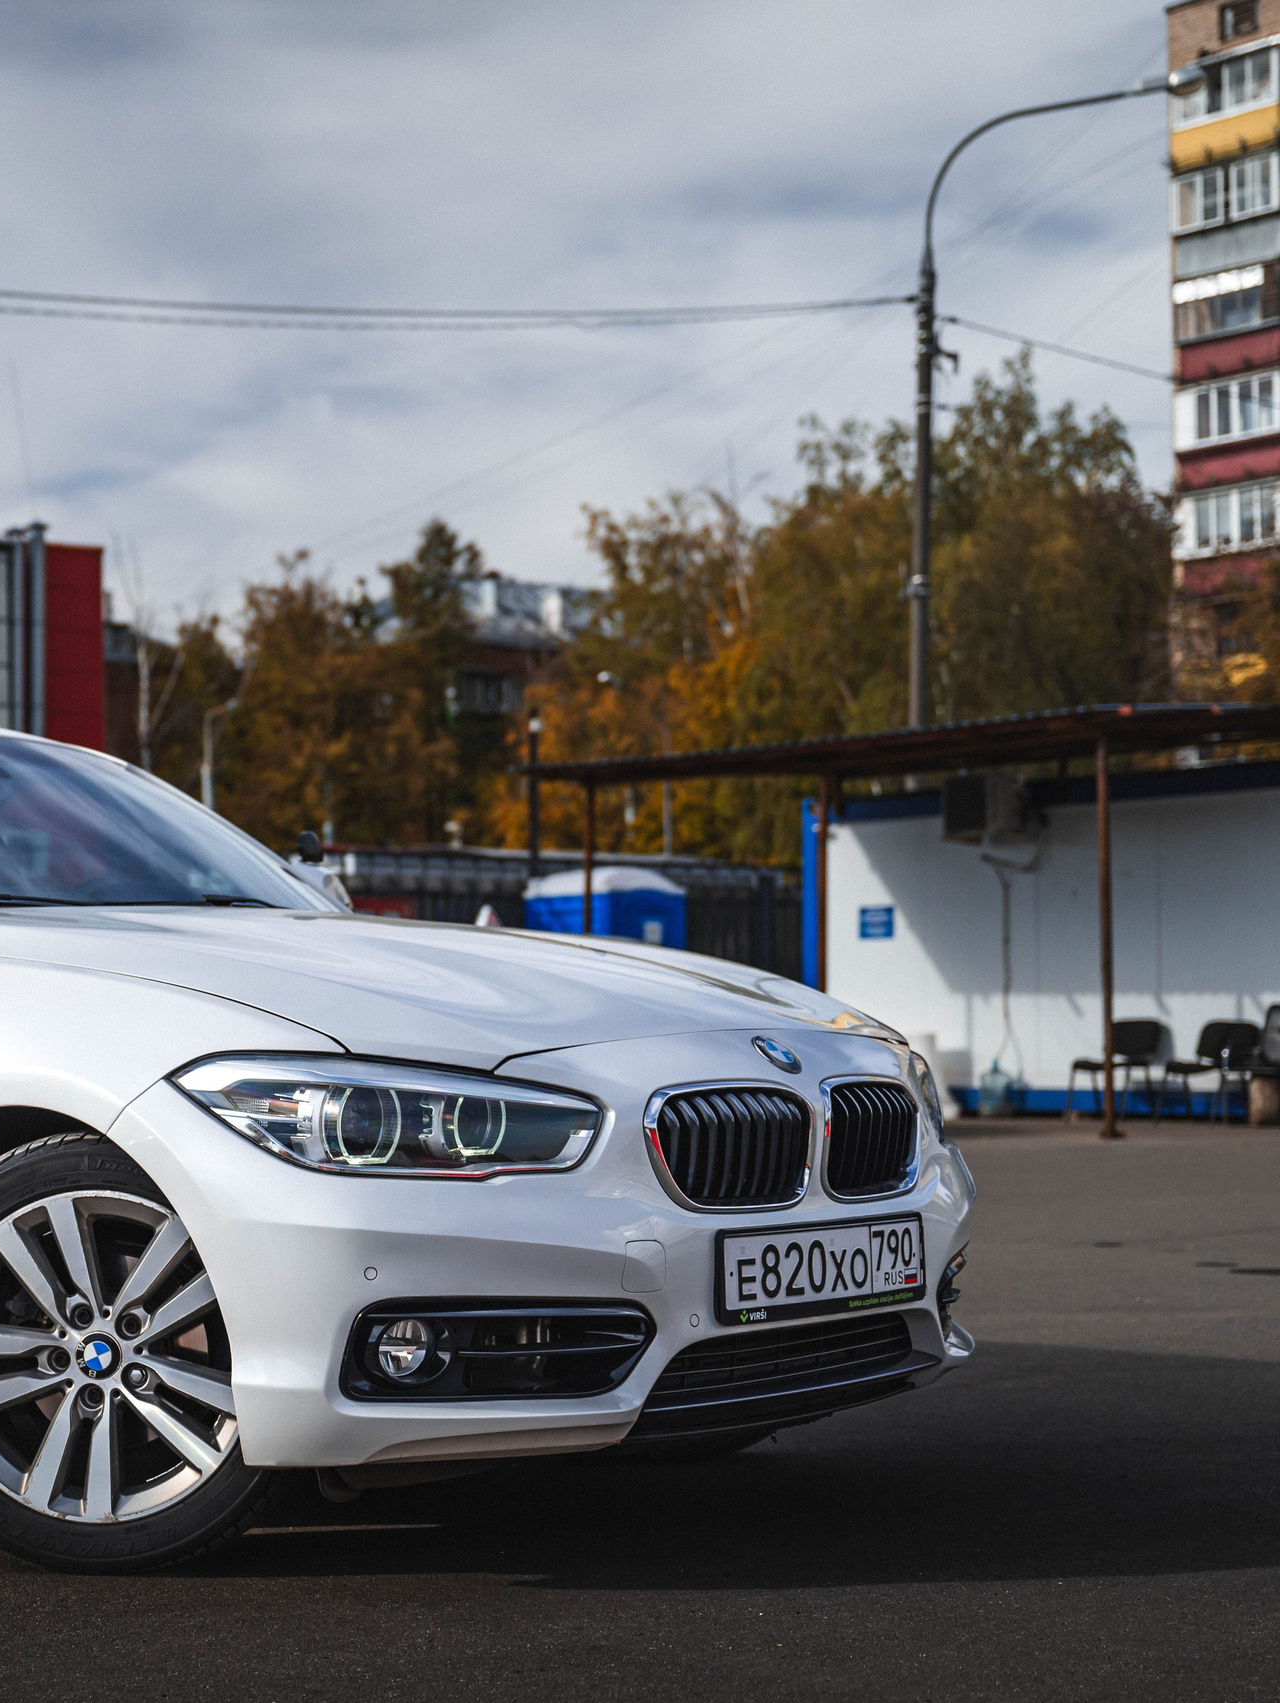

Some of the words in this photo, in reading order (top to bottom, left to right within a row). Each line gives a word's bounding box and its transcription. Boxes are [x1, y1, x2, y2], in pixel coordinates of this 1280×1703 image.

[872, 1226, 913, 1272] 790
[884, 1270, 904, 1287] RUS
[749, 1308, 767, 1321] VIRŠI
